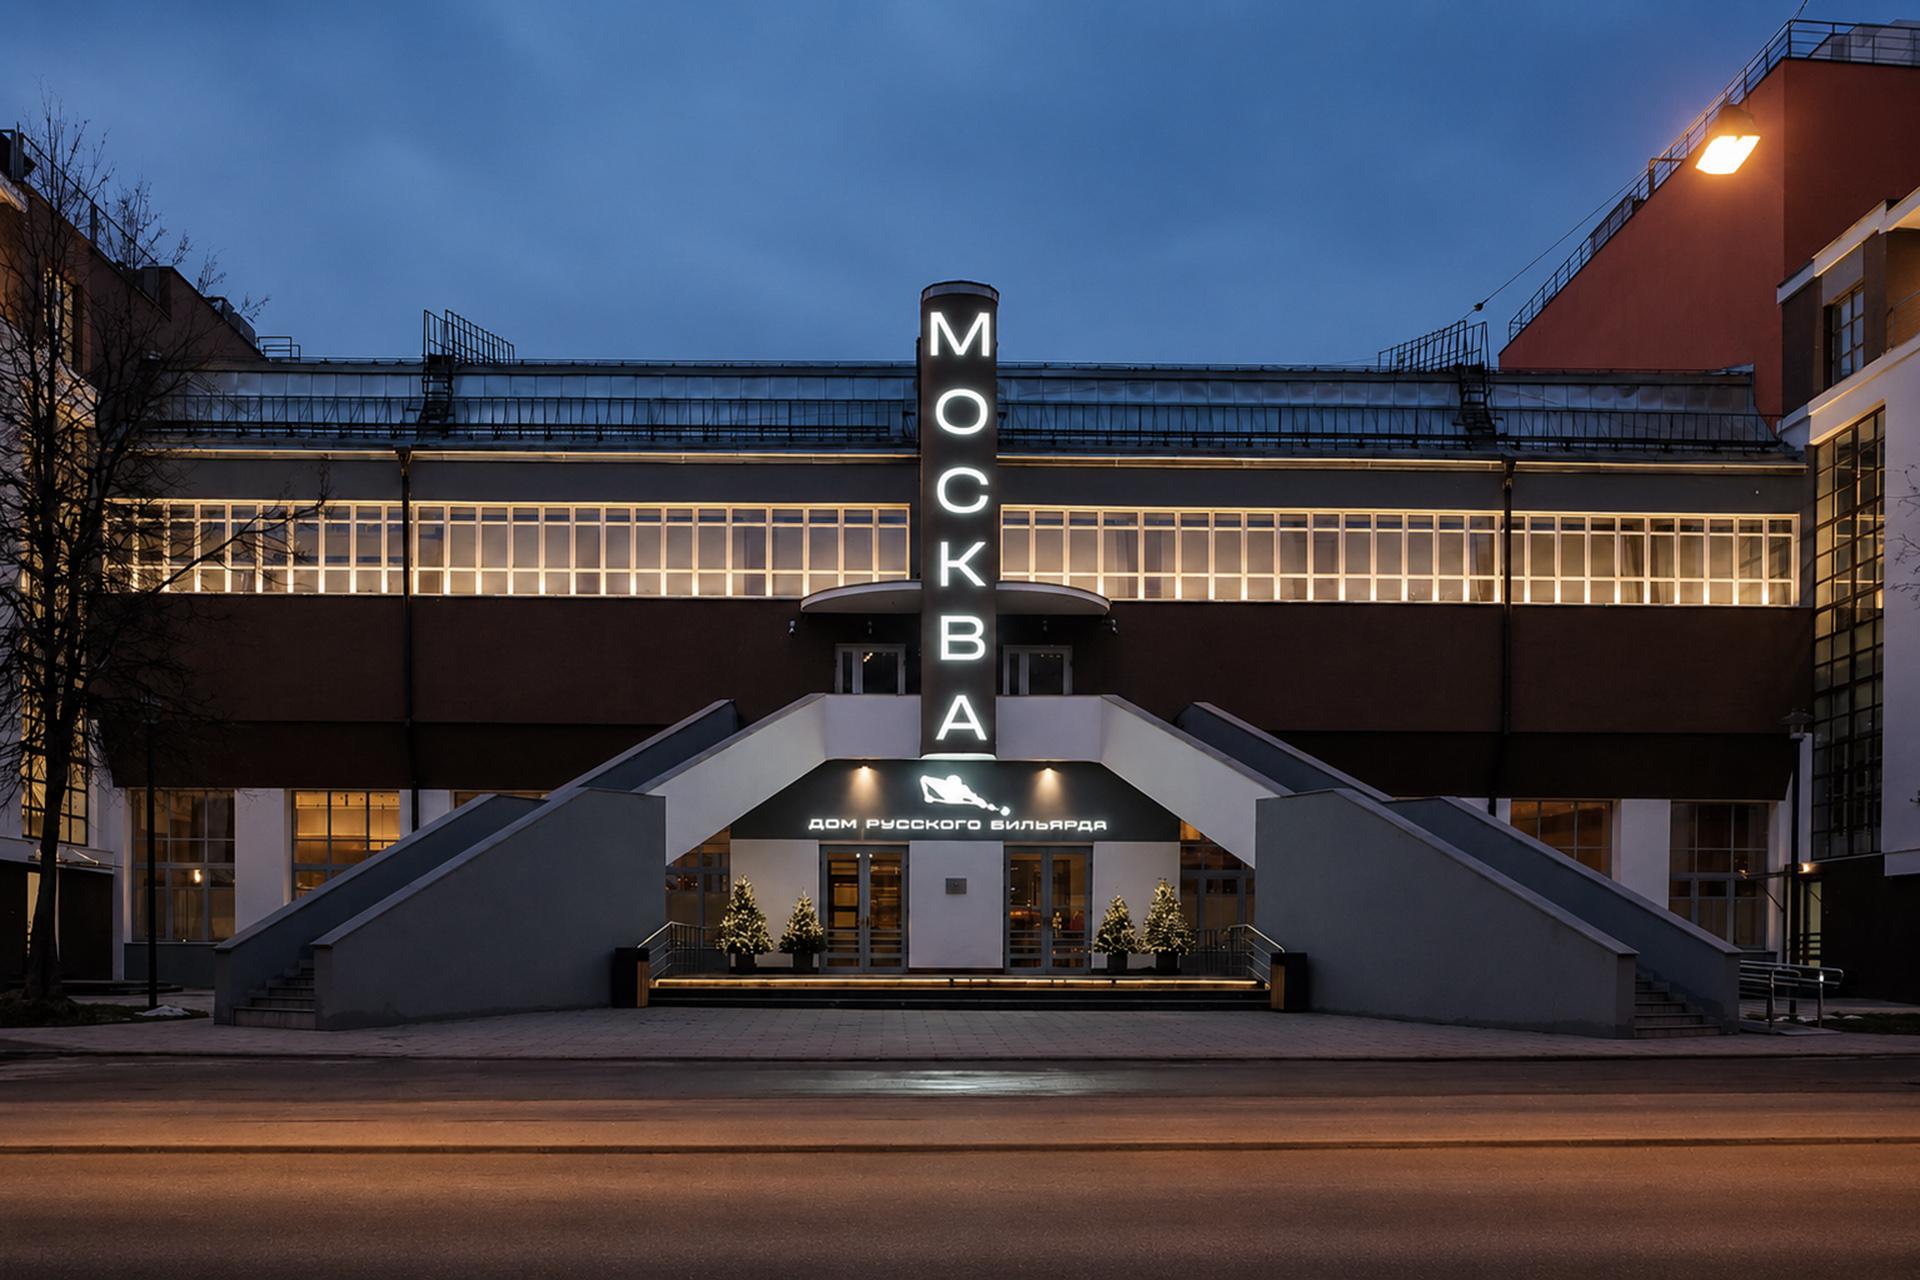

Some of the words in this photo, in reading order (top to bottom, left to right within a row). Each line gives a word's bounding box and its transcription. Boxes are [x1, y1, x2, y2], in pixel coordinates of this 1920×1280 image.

[929, 311, 991, 742] МОСКВА
[808, 818, 858, 831] ДОМ
[865, 818, 982, 831] РУССКОГО
[990, 818, 1108, 833] БИЛЬЯРДА
